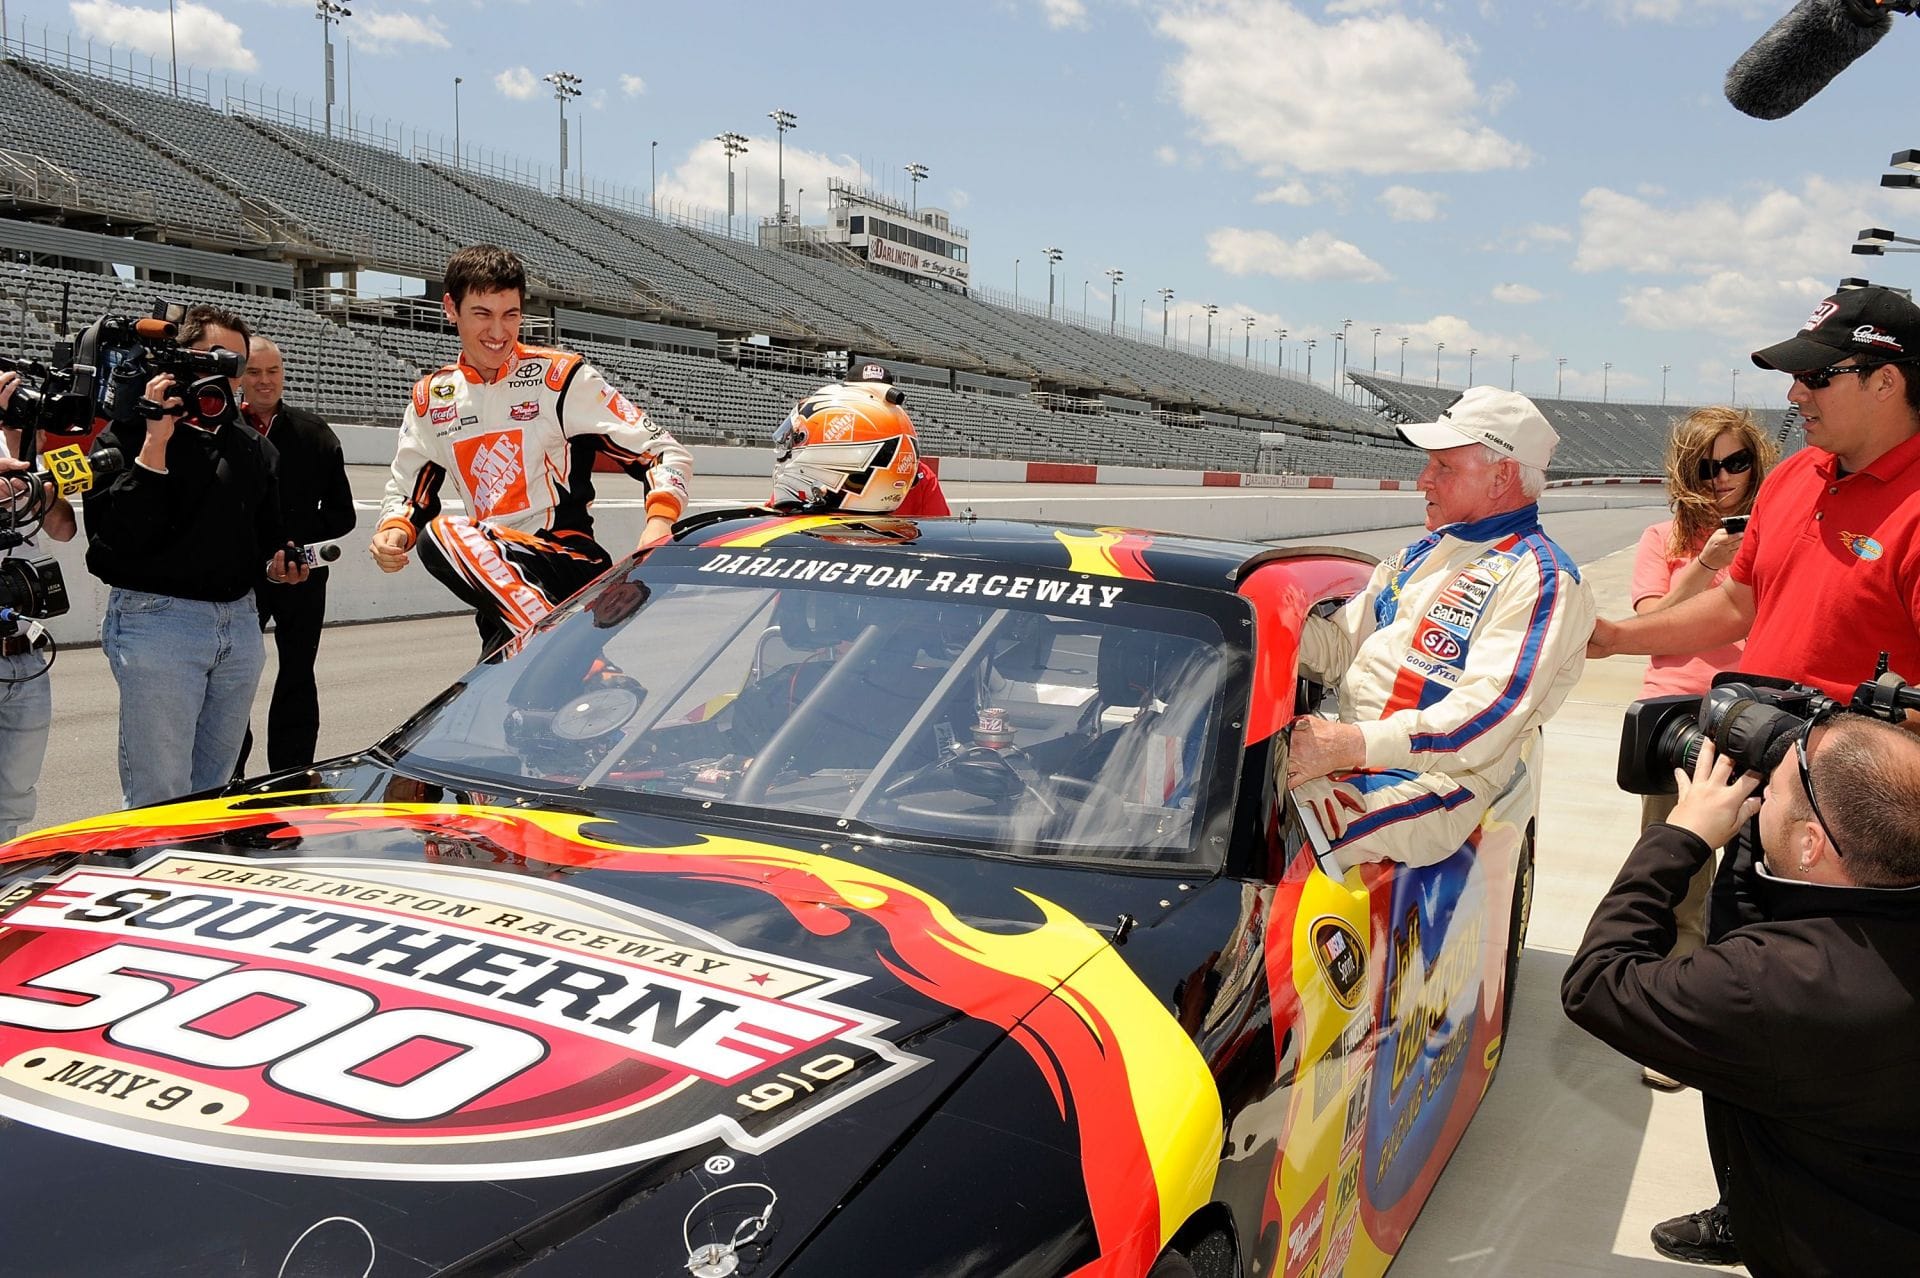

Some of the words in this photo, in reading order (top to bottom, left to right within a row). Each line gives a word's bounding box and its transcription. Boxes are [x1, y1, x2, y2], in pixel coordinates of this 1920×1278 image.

[875, 238, 919, 269] DARLINGTON
[474, 434, 520, 514] HOME
[698, 553, 920, 590] DARLINGTON
[926, 571, 1124, 609] RACEWAY
[1454, 579, 1487, 598] CHAMPION
[1424, 632, 1457, 655] STP
[201, 868, 481, 919] DARLINGTON
[485, 912, 730, 976] RACEWAY
[65, 888, 741, 1049] SOUTHERN
[1391, 912, 1482, 1092] GORDON
[0, 943, 551, 1122] 500
[43, 1060, 153, 1100] MAY
[146, 1084, 194, 1111] 9
